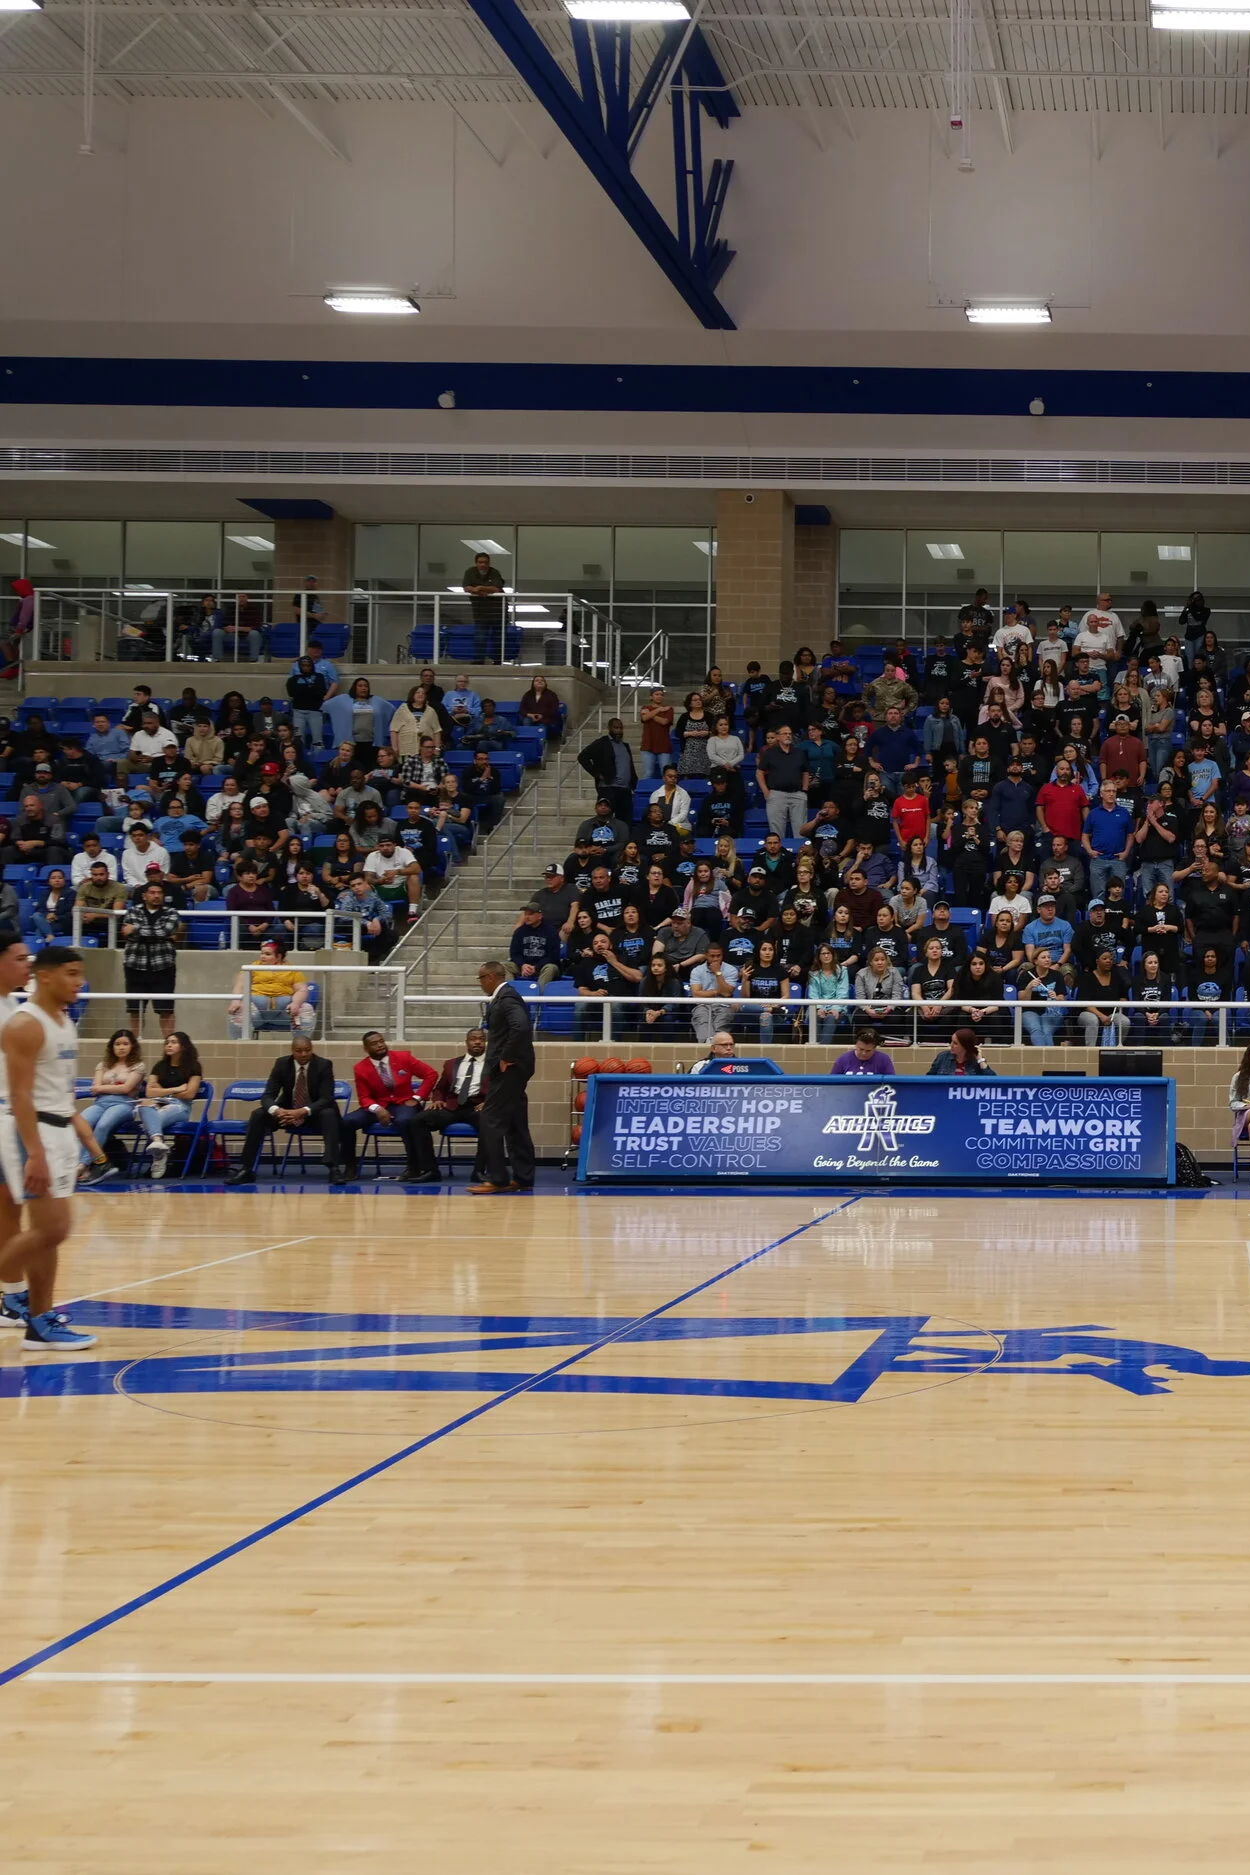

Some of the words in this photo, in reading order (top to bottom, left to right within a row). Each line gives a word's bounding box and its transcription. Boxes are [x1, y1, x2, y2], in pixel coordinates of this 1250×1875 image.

[618, 1086, 752, 1098] RESPONSIBILITY
[753, 1086, 823, 1098] RESPECT
[948, 1087, 1037, 1100] HUMILITY
[1038, 1087, 1142, 1101] COURAGE
[616, 1100, 738, 1114] INTEGRITY
[741, 1100, 803, 1113] HOPE
[978, 1102, 1142, 1117] PERSEVERANCE
[614, 1116, 781, 1134] LEADERSHIP
[822, 1115, 936, 1134] ATHLETICS
[980, 1118, 1142, 1136] TEAMWORK
[613, 1136, 683, 1151] TRUST
[688, 1136, 782, 1151] VALUES
[965, 1137, 1088, 1150] COMMITMENT
[1088, 1138, 1141, 1151] GRIT
[611, 1153, 767, 1168] SELF-CONTROL
[813, 1155, 844, 1170] Going
[846, 1155, 889, 1170] Beyond
[889, 1155, 907, 1167] the
[909, 1155, 940, 1168] Game
[976, 1153, 1141, 1169] COMPASSION
